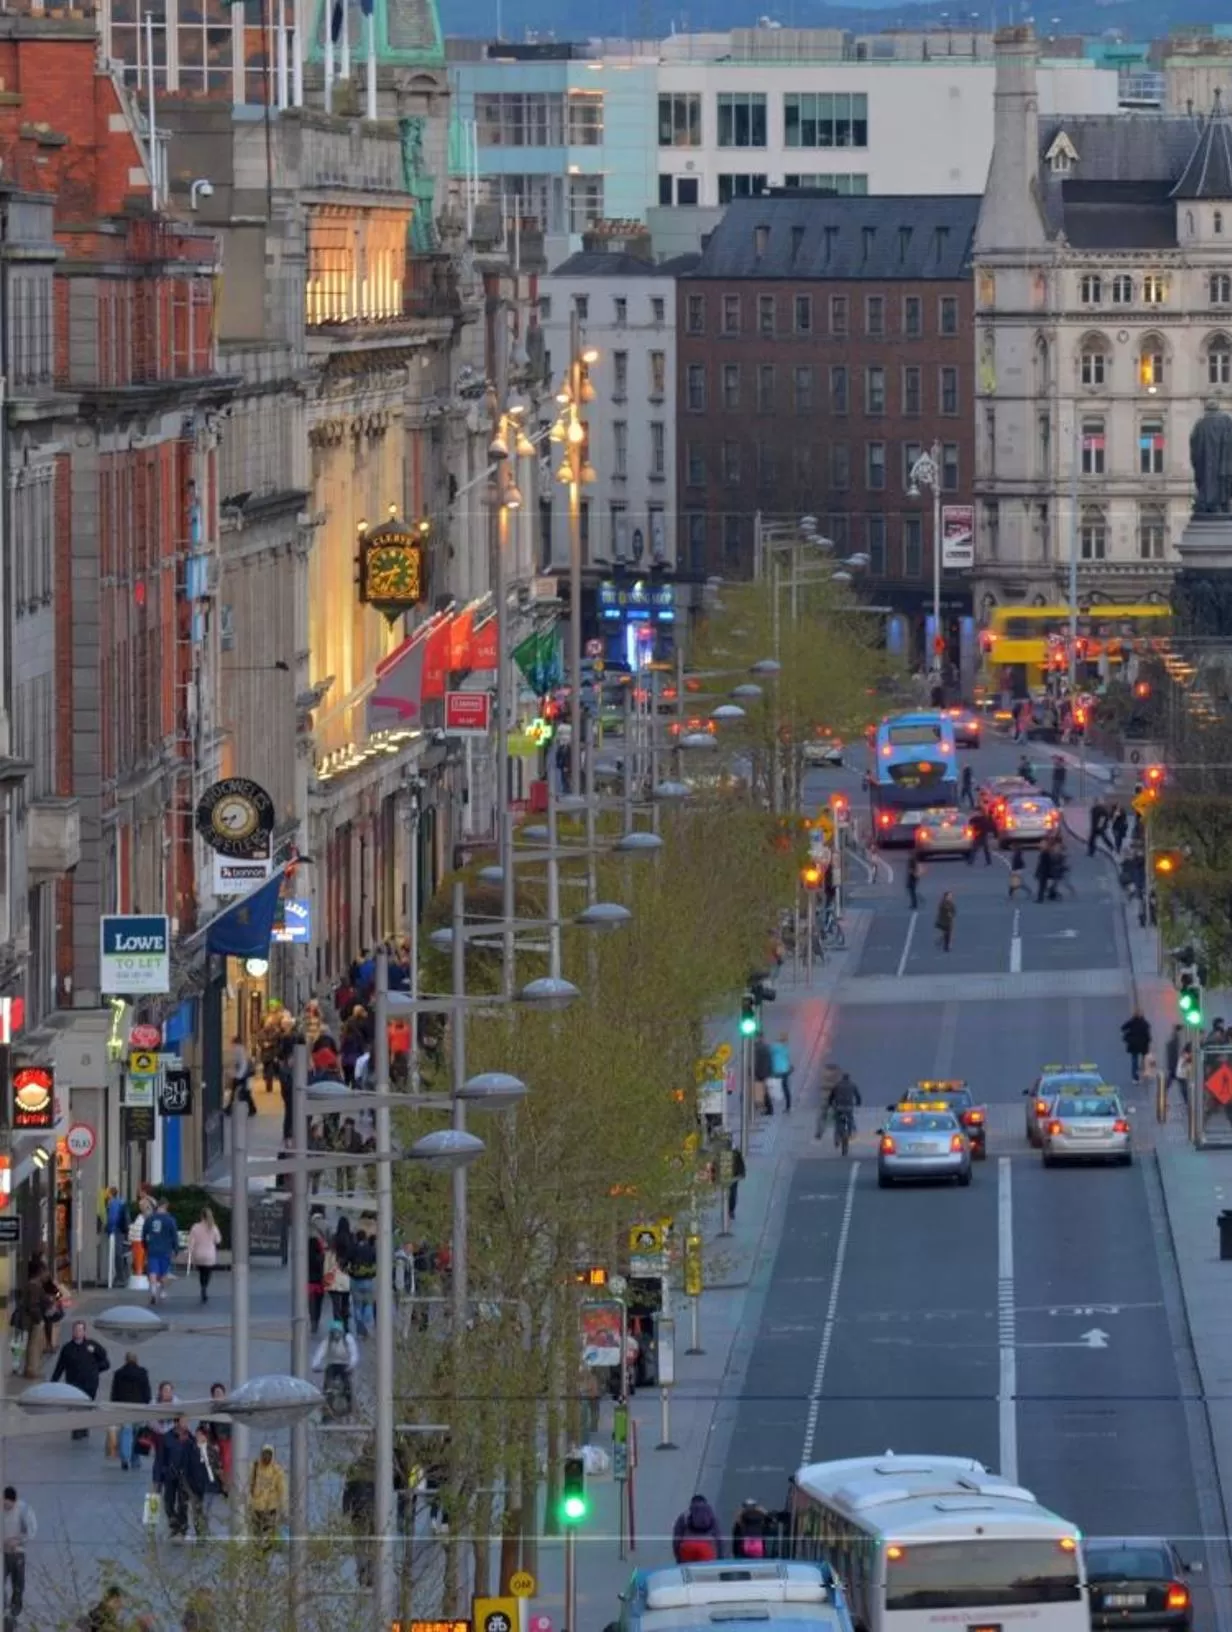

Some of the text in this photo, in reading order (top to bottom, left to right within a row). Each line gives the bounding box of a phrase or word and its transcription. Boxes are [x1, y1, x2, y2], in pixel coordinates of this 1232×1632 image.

[115, 932, 164, 951] LOWE
[115, 958, 162, 969] TO LET
